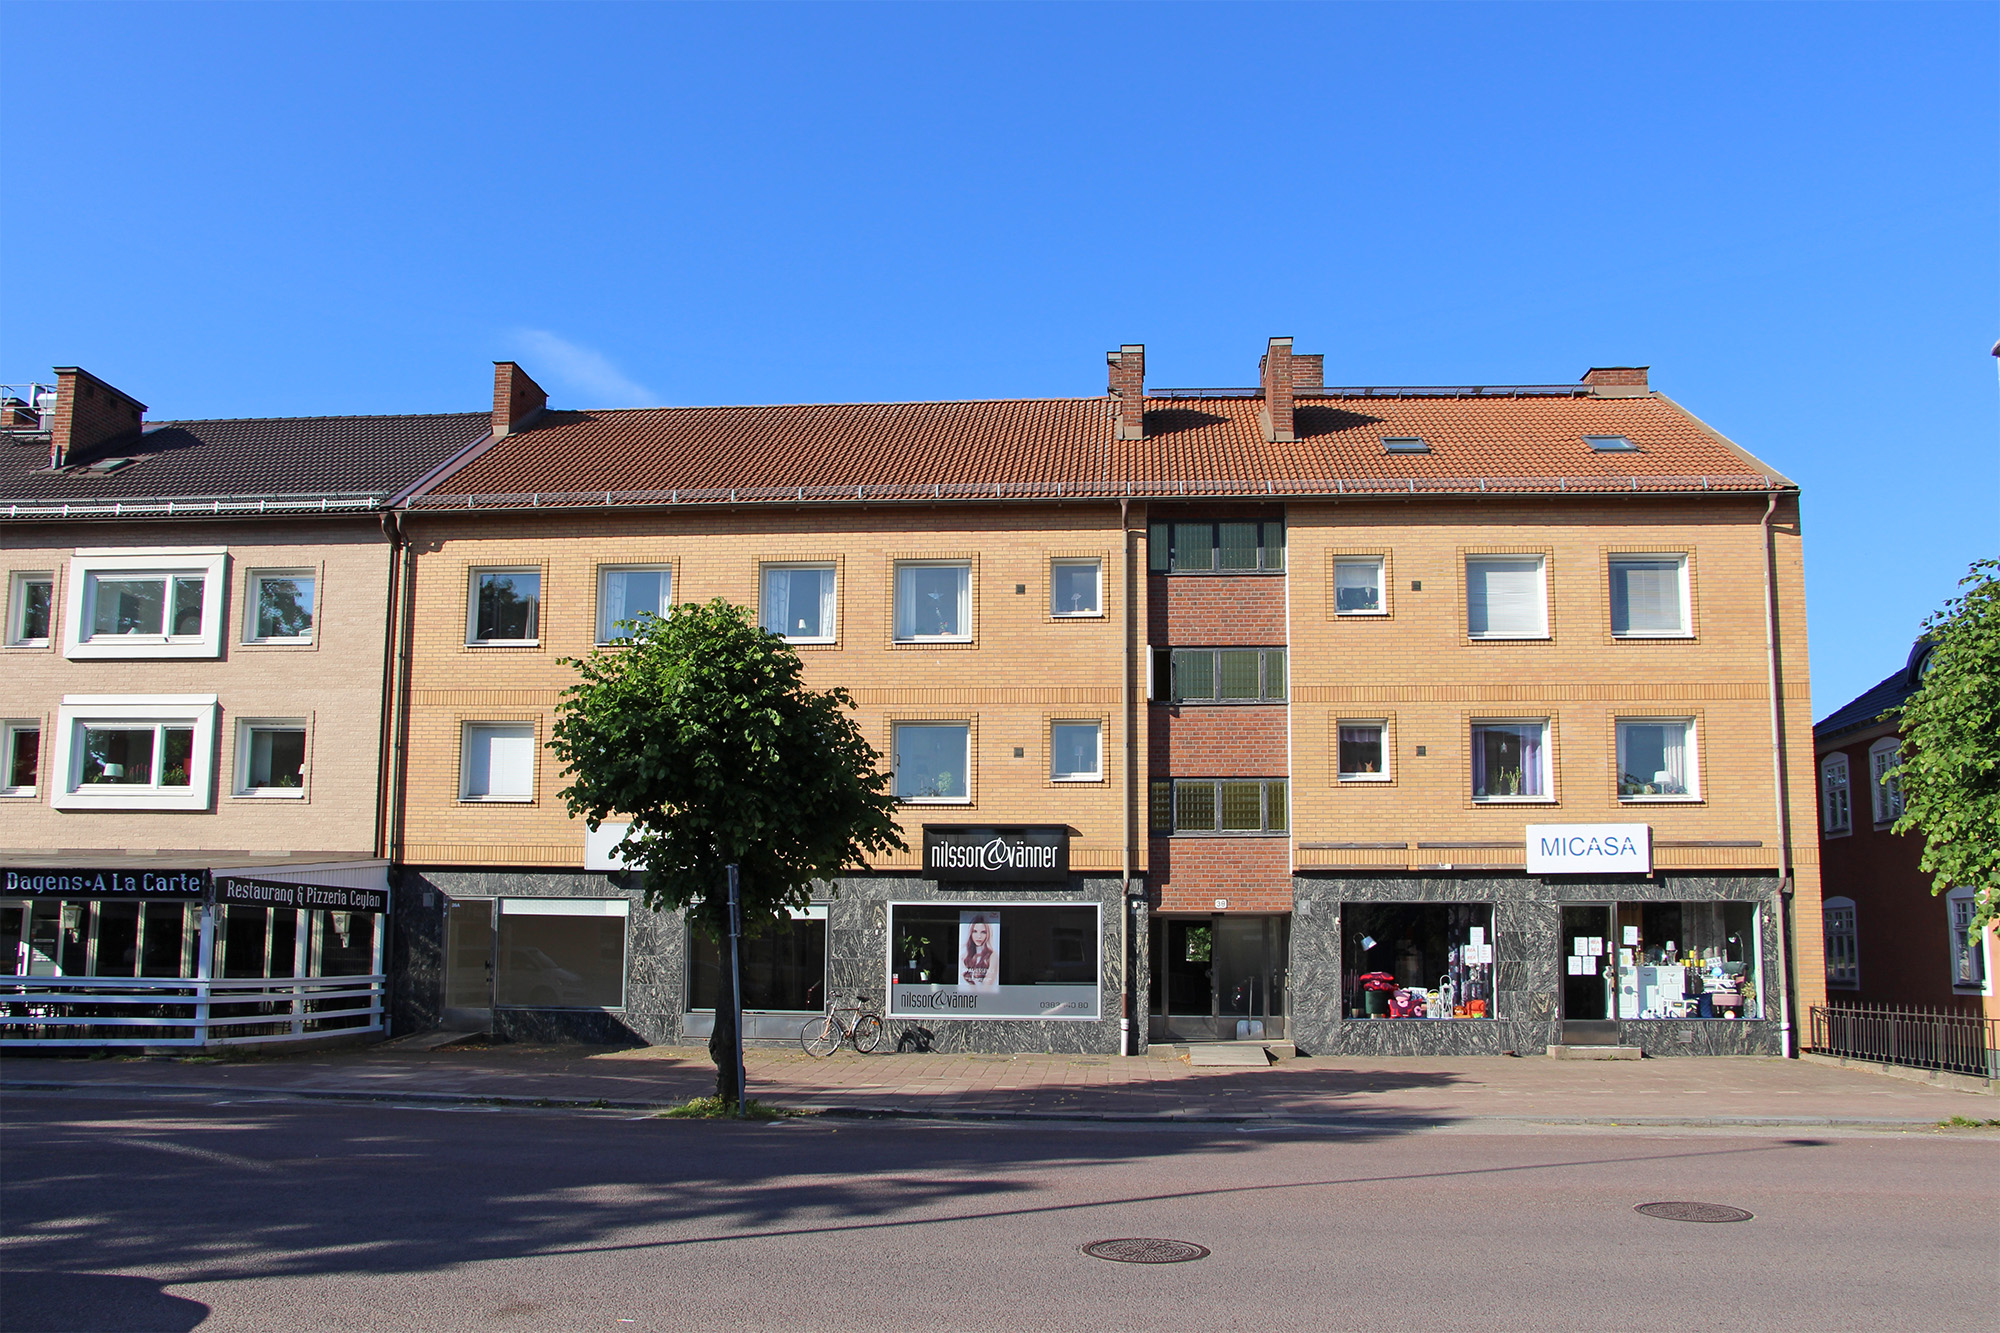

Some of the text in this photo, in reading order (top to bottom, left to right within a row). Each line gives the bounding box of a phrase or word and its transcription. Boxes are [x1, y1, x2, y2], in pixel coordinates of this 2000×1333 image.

[1541, 836, 1637, 856] MICASA
[6, 872, 83, 894] Dagens
[112, 873, 137, 892] La
[143, 873, 200, 892] Carte
[227, 879, 381, 909] Restaurang & Pizzeria Ceylan
[1078, 1001, 1089, 1009] 80
